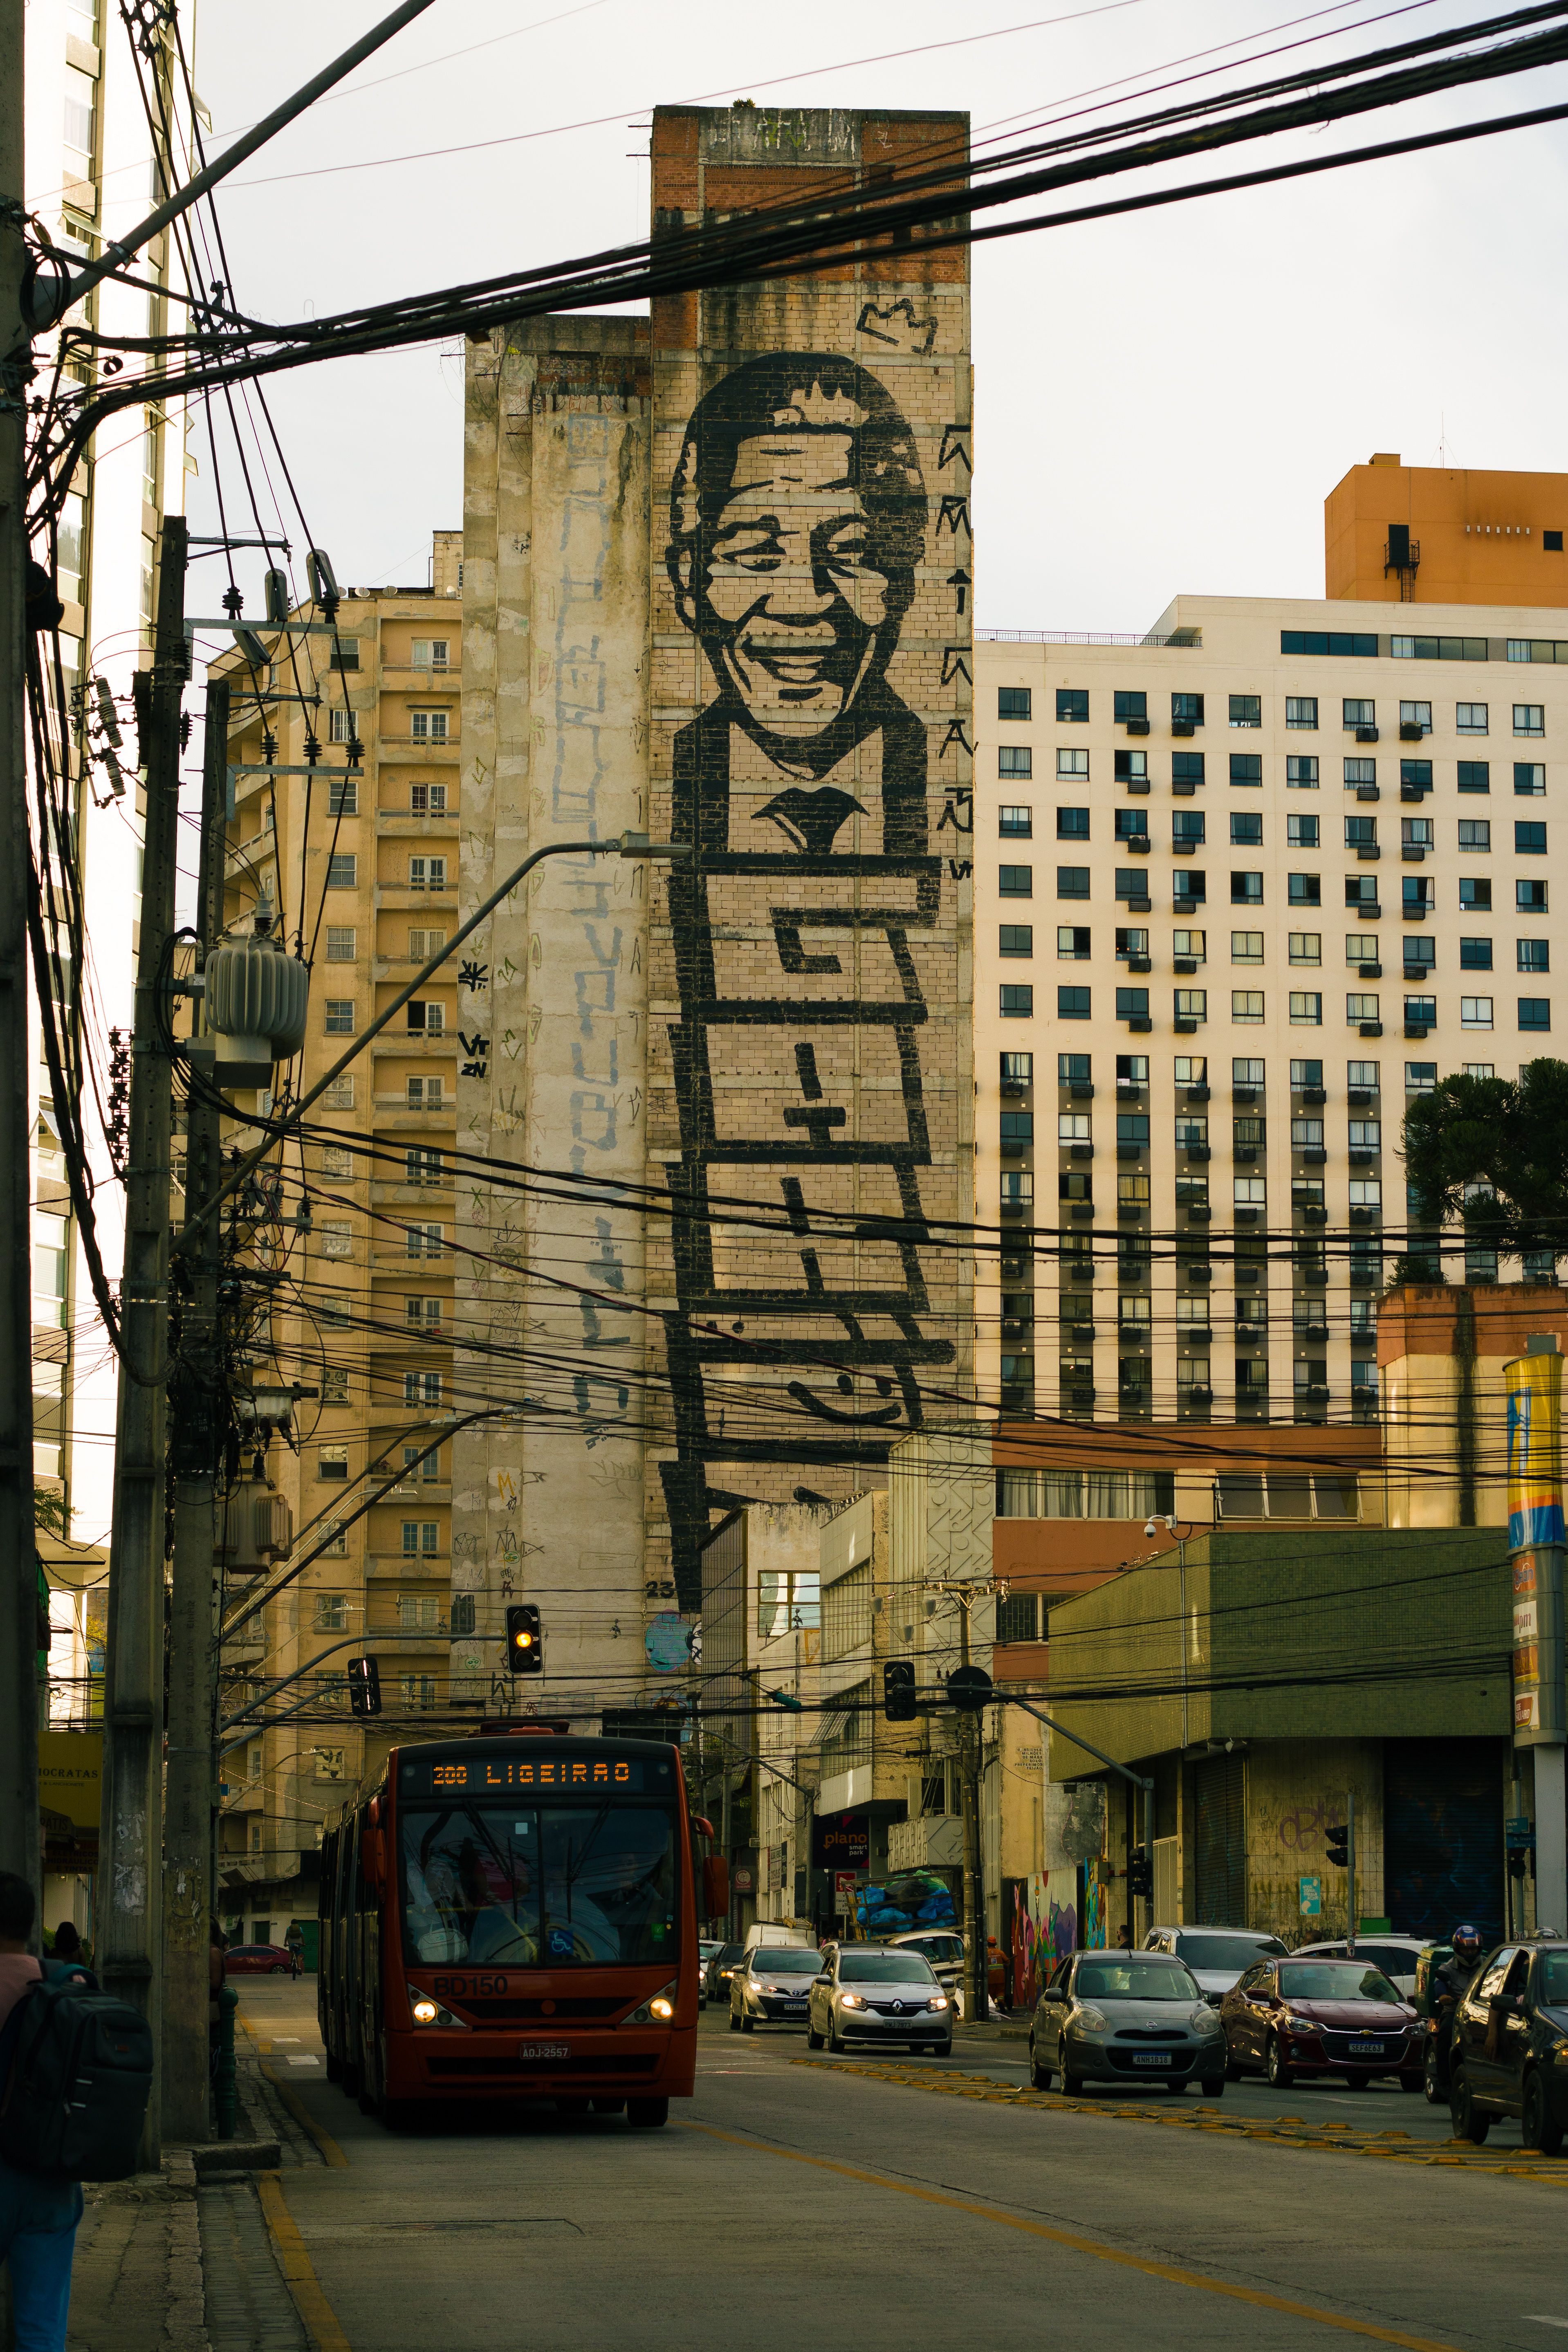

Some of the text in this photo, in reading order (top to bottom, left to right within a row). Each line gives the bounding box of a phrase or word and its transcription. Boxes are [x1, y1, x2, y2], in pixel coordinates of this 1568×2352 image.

[646, 1581, 675, 1598] 23
[433, 1763, 630, 1784] 200 LIGEIRAO
[823, 1831, 868, 1850] plano
[434, 1976, 508, 1996] BD150
